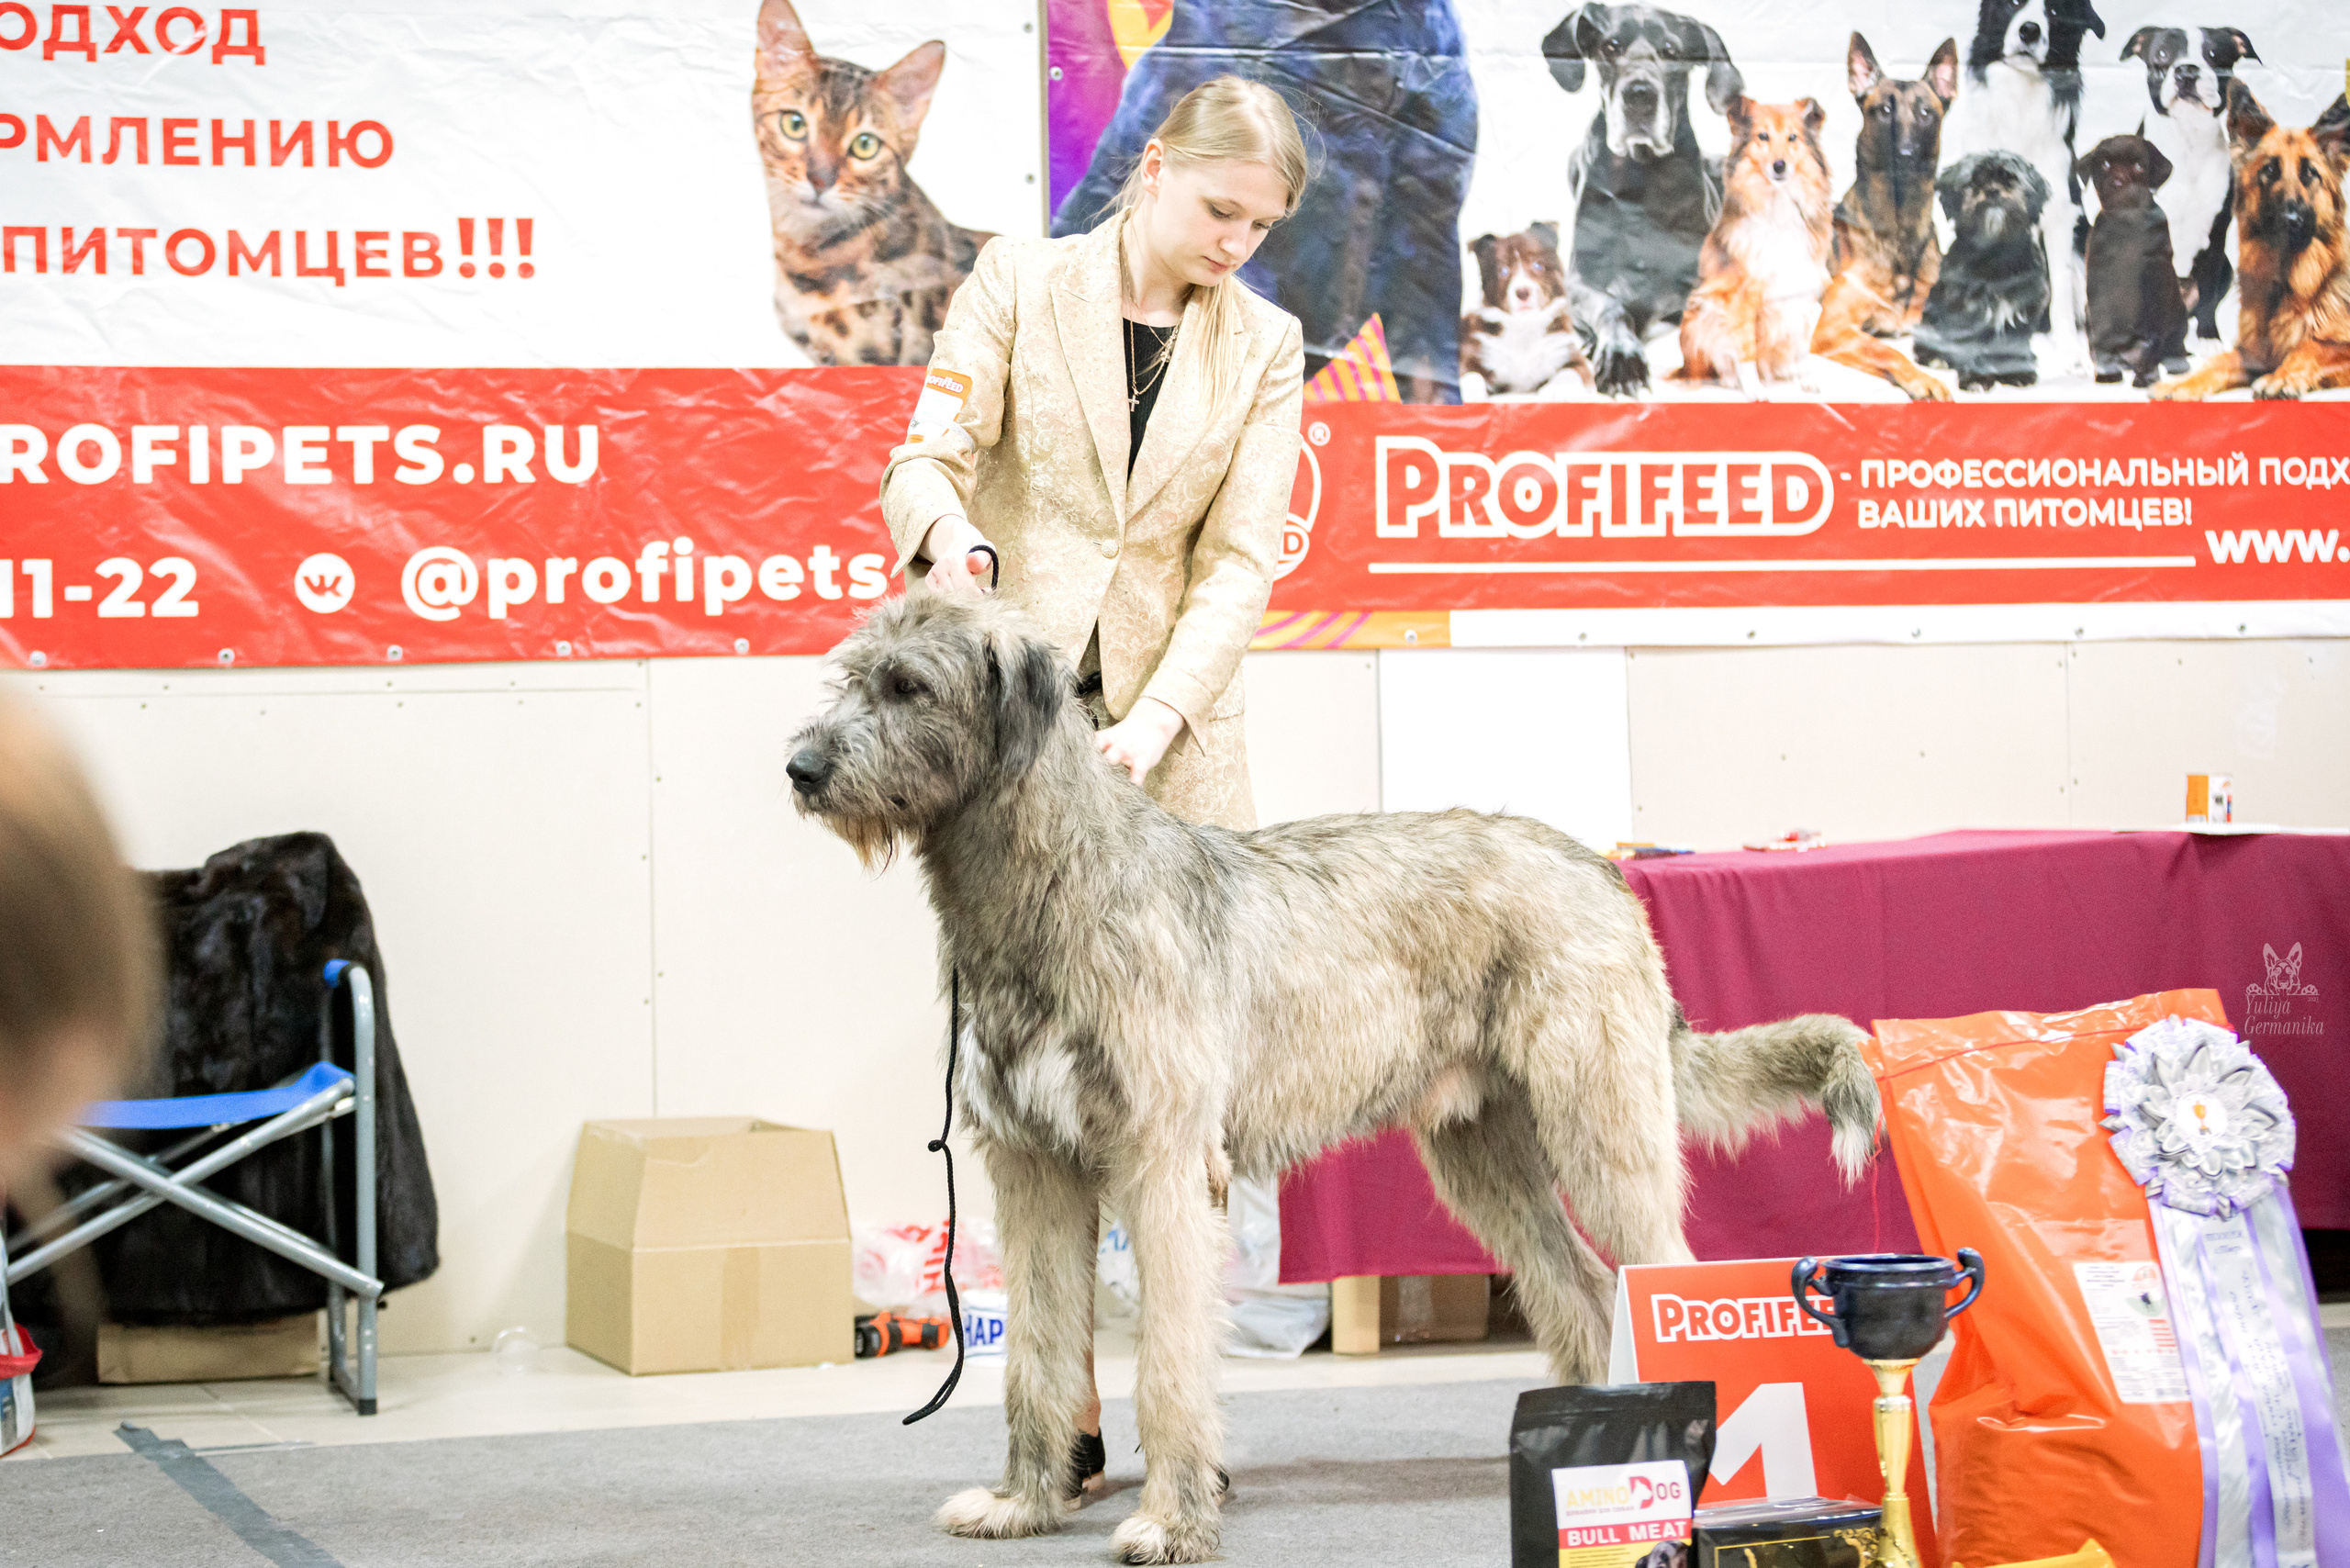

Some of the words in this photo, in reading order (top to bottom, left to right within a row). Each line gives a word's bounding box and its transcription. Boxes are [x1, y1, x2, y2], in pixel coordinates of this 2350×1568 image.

[3, 217, 535, 286] ПИТОМЦЕВ!!!
[0, 423, 599, 485] ROFIPETS.RU
[1860, 452, 2249, 489] ПРОФЕССИОНАЛЬНЫЙ
[2259, 456, 2350, 490] ПОДХ
[1376, 435, 1834, 539] PROFIFEED
[1858, 498, 1986, 529] ВАШИХ
[1994, 497, 2192, 532] ПИТОМЦЕВ!
[400, 536, 889, 622] @profipets
[1567, 1528, 1622, 1548] BULL
[1628, 1521, 1686, 1541] MEAT
